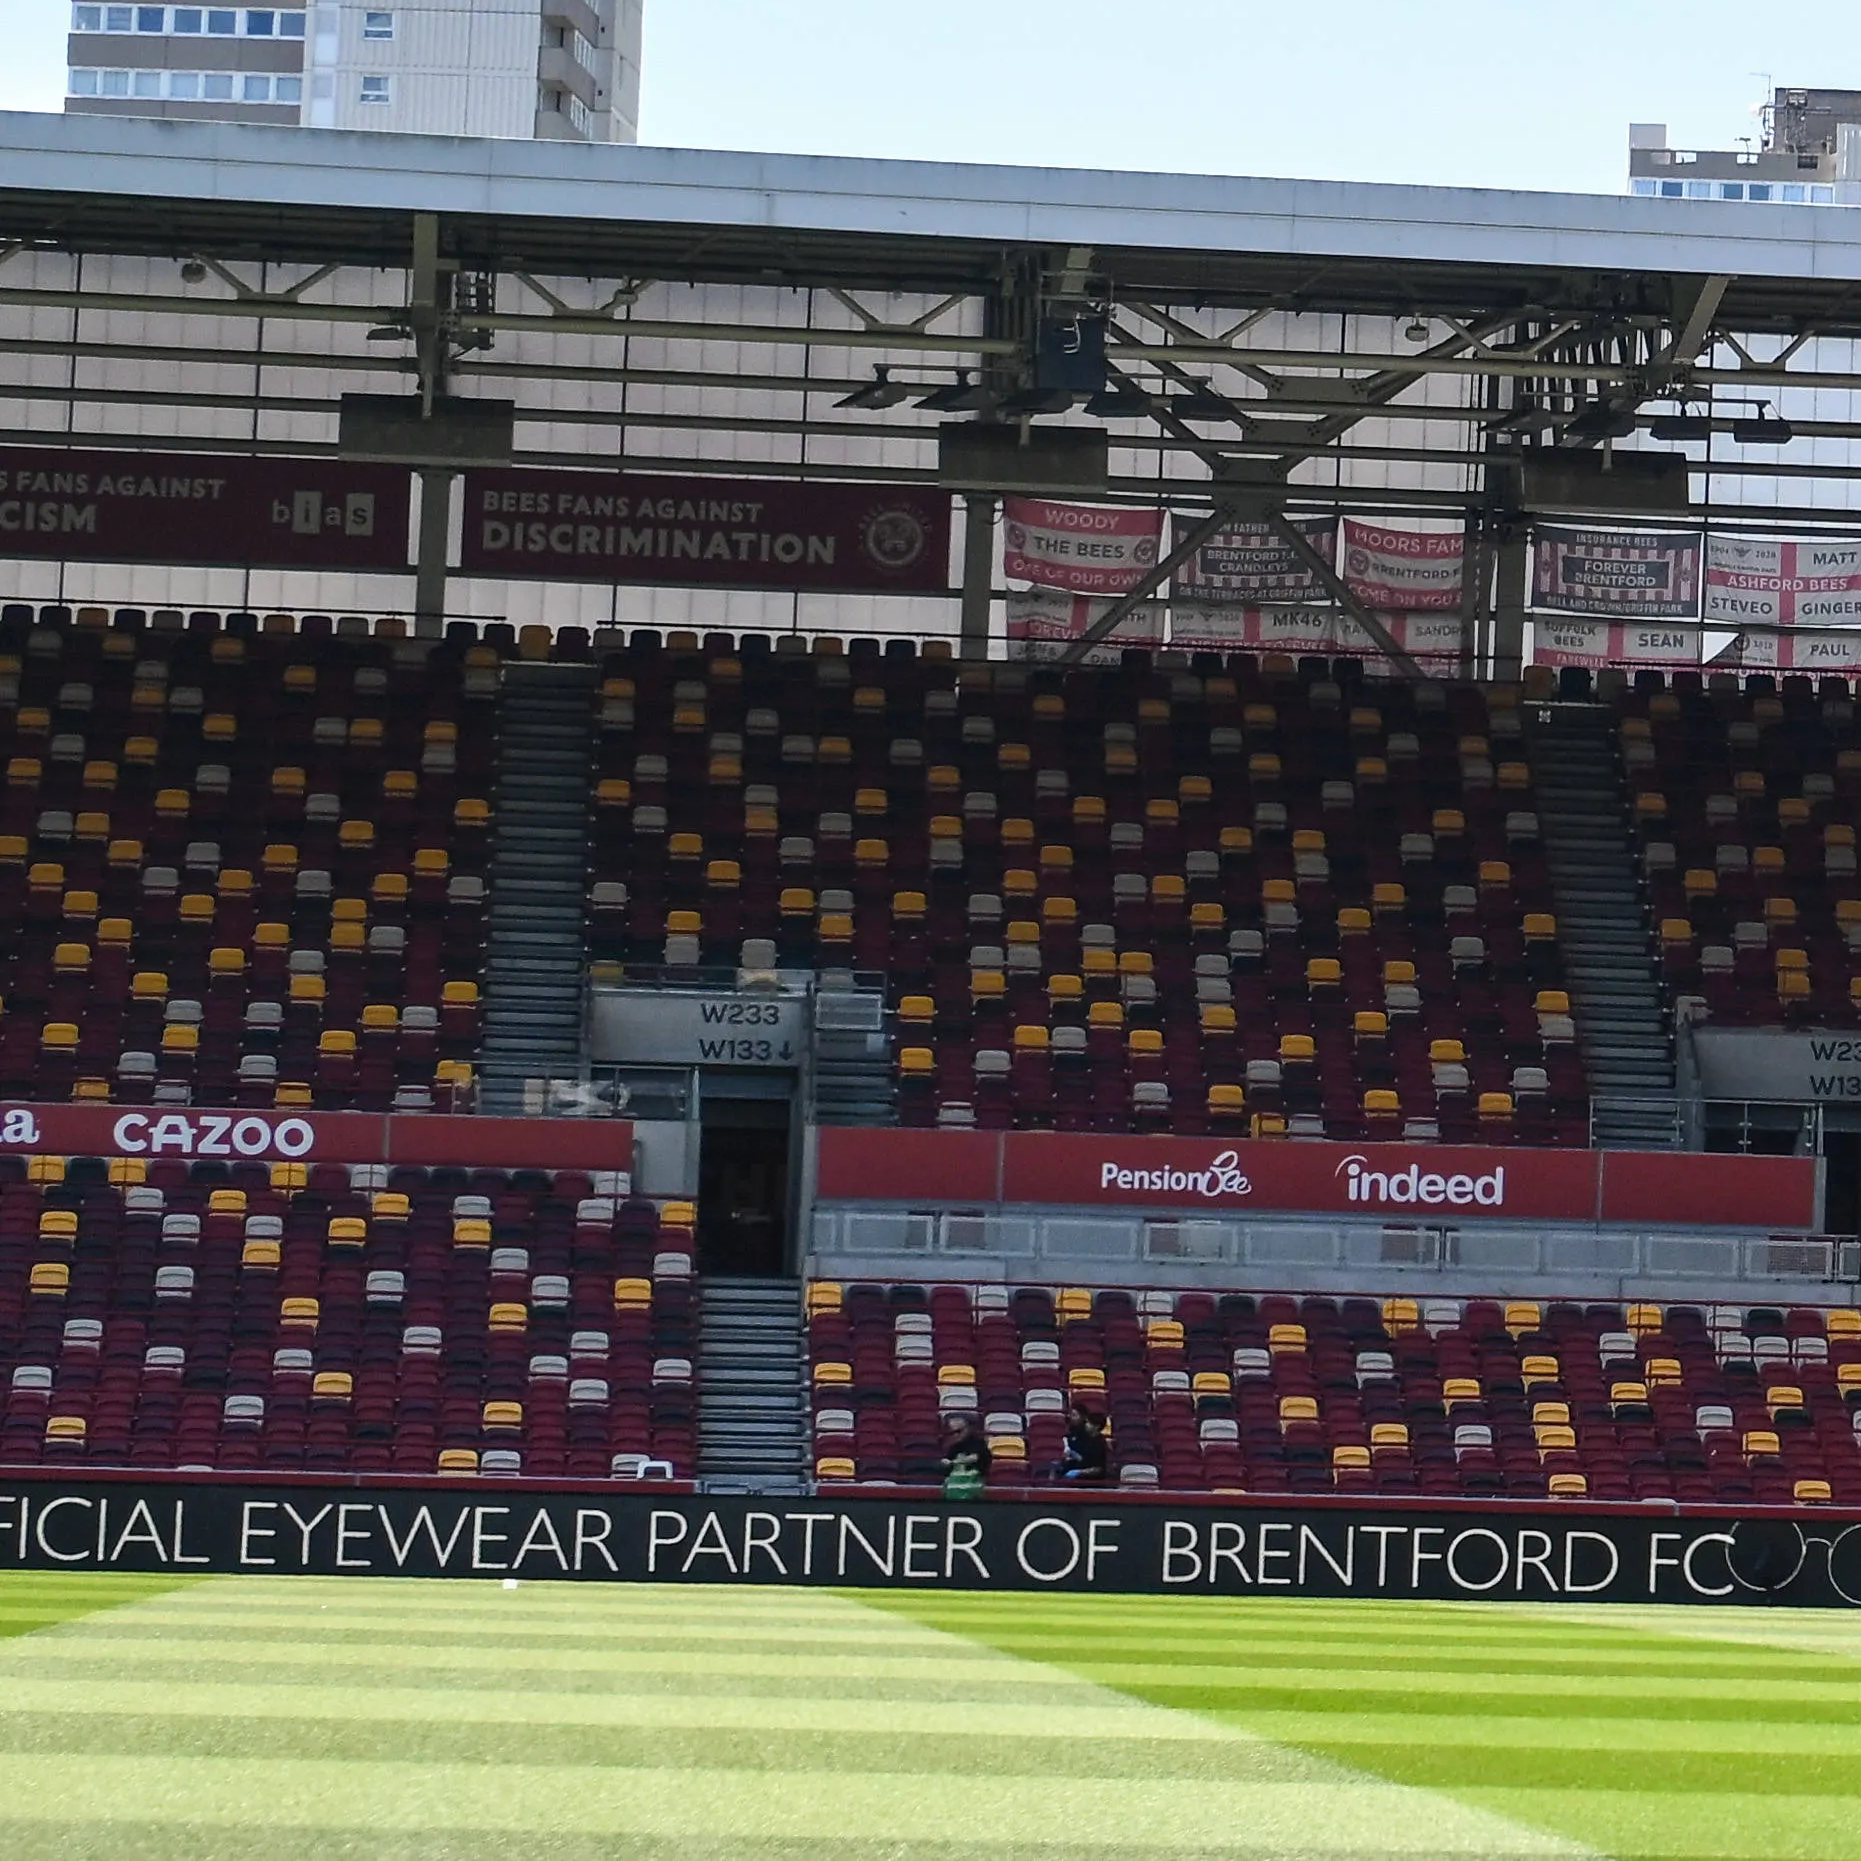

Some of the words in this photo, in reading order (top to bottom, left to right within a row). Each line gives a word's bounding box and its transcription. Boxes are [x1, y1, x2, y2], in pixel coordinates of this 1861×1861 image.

[16, 472, 89, 494] FANS
[96, 475, 225, 499] AGAINST
[482, 490, 550, 514] BEES
[557, 493, 628, 517] FANS
[636, 497, 763, 523] AGAINST
[1045, 508, 1120, 530] WOODY
[482, 520, 836, 565] DISCRIMINATION
[1034, 535, 1071, 554] THE
[1077, 540, 1124, 558] BEES
[1207, 549, 1280, 562] BRENTFORD
[1813, 551, 1857, 565] MATT
[1585, 560, 1647, 574] FOREVER
[1070, 572, 1104, 586] OUR
[1575, 572, 1656, 586] BRENTFORD
[1727, 575, 1804, 591] ASHFORD
[1809, 578, 1848, 591] BEES
[1710, 597, 1773, 614] STEVEO
[1638, 633, 1684, 648] SEAN
[1810, 644, 1850, 657] PAUL
[701, 1003, 781, 1026] W233
[698, 1038, 772, 1061] W133
[112, 1113, 315, 1156] CAZOO
[1101, 1150, 1252, 1197] PensionBee
[1336, 1154, 1505, 1206] indeed
[240, 1501, 619, 1573] EYEWEAR
[648, 1510, 991, 1578] PARTNER
[1017, 1517, 1121, 1582] OF
[1162, 1520, 1619, 1593] BRENTFORD
[1649, 1532, 1734, 1596] FC
